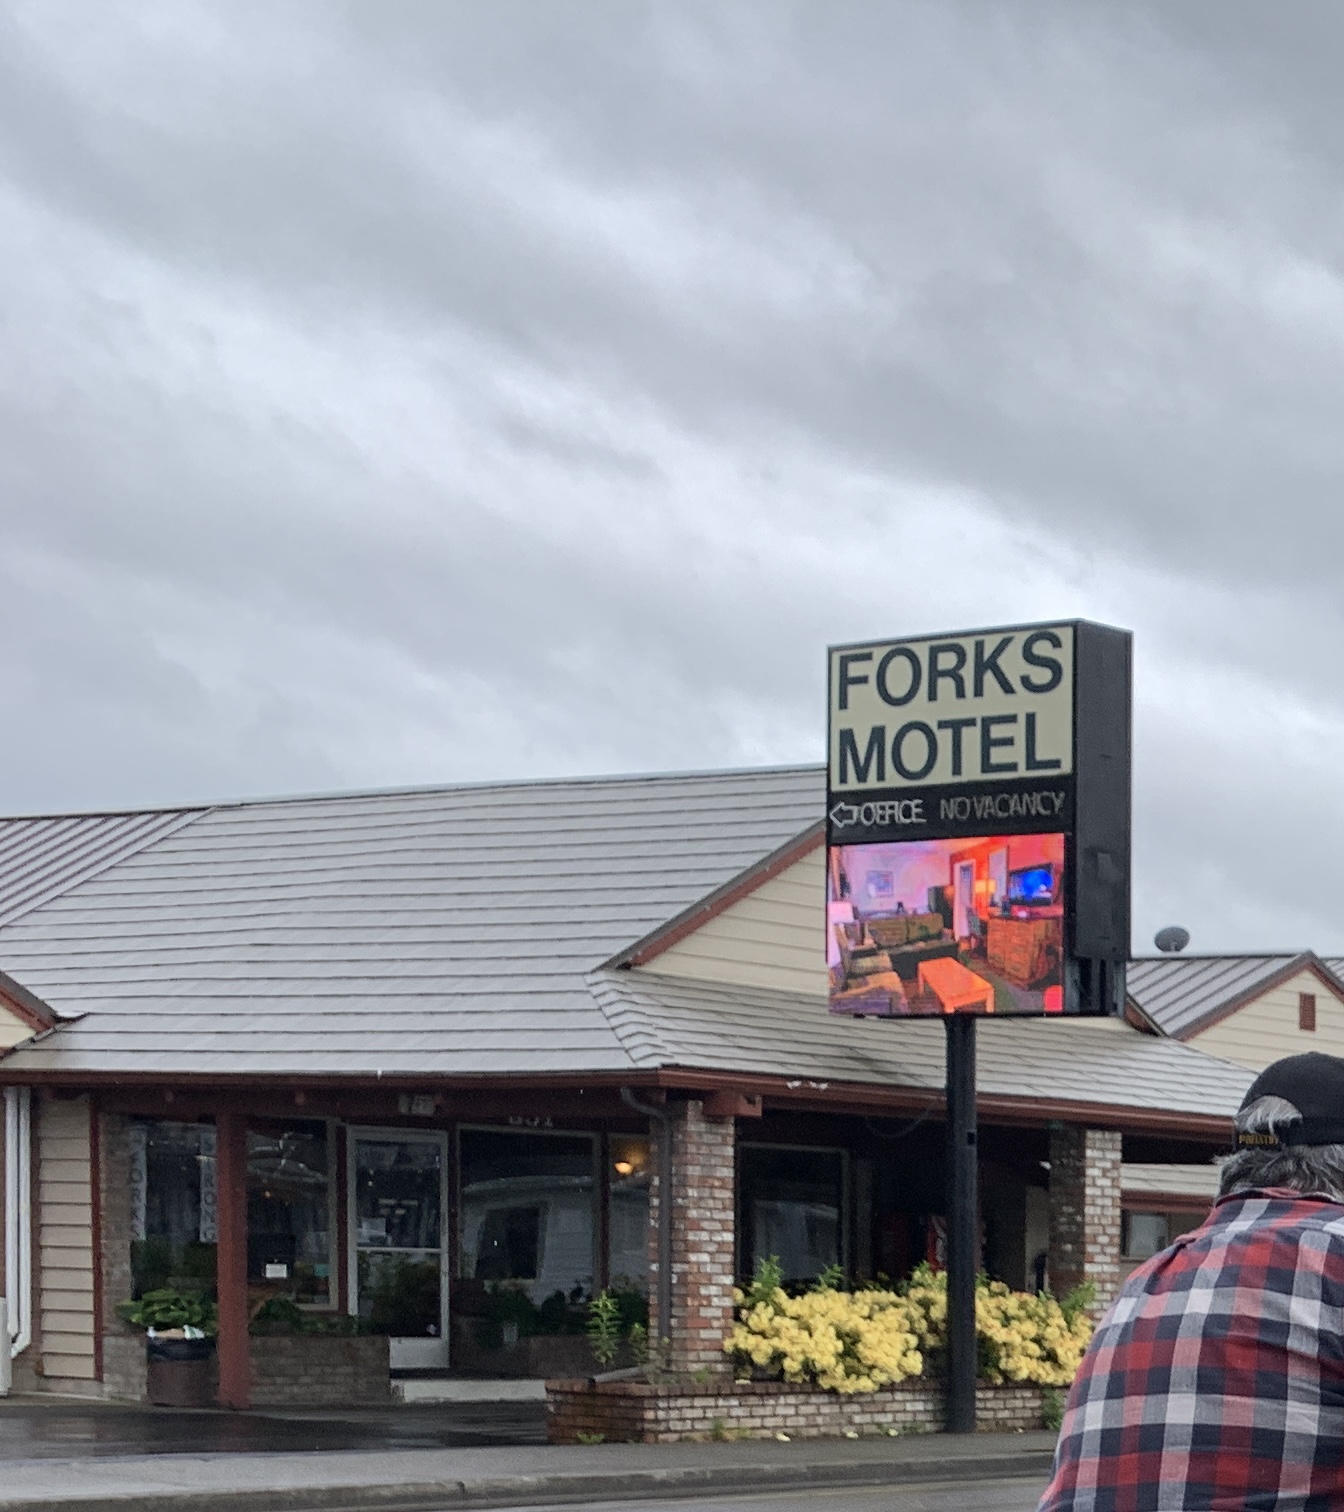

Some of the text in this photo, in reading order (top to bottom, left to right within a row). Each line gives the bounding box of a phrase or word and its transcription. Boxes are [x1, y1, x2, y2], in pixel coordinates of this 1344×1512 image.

[837, 629, 1064, 711] FORKS
[837, 711, 1063, 785] MOTEL
[859, 799, 928, 826] OFFICE
[939, 791, 1066, 820] NO VACANCY
